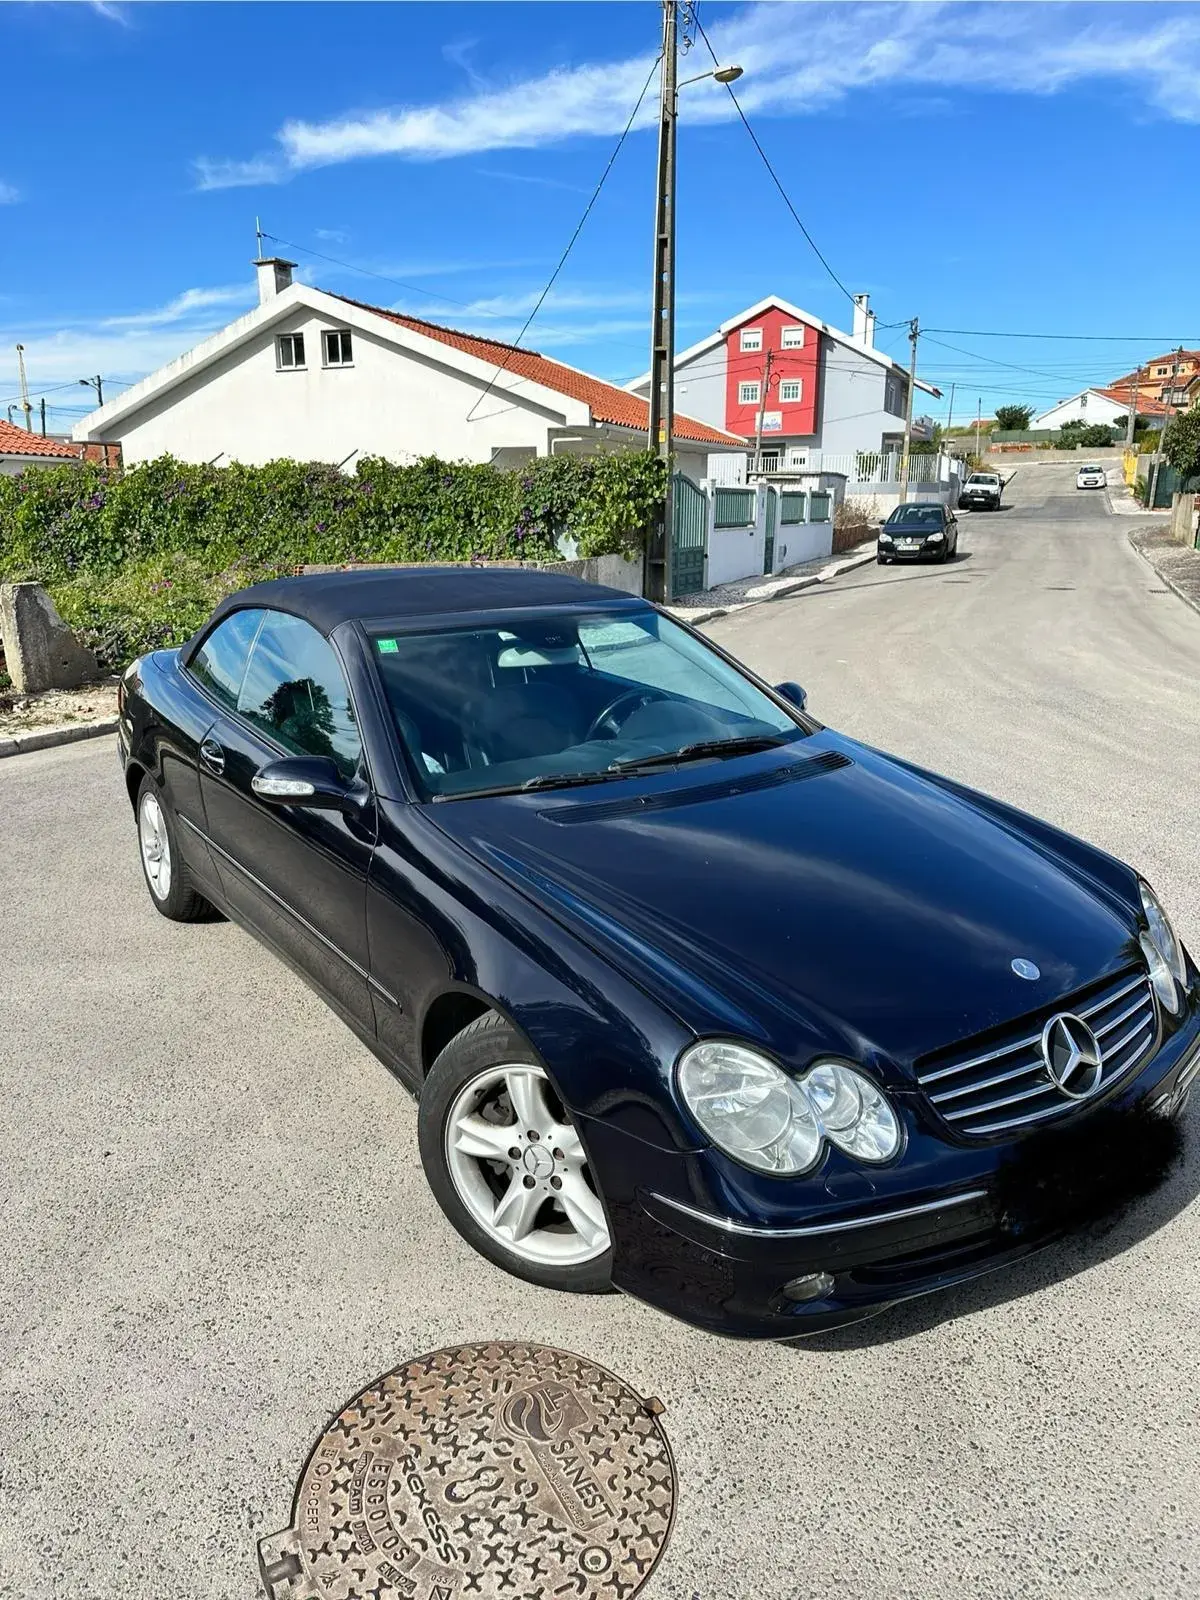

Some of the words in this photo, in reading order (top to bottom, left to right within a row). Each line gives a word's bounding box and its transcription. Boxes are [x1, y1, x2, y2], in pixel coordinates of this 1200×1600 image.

[367, 1464, 410, 1561] ESGOTOS
[397, 1454, 459, 1564] REXESS
[550, 1440, 615, 1519] SANEST
[379, 1563, 395, 1578] EN
[394, 1573, 414, 1592] 124
